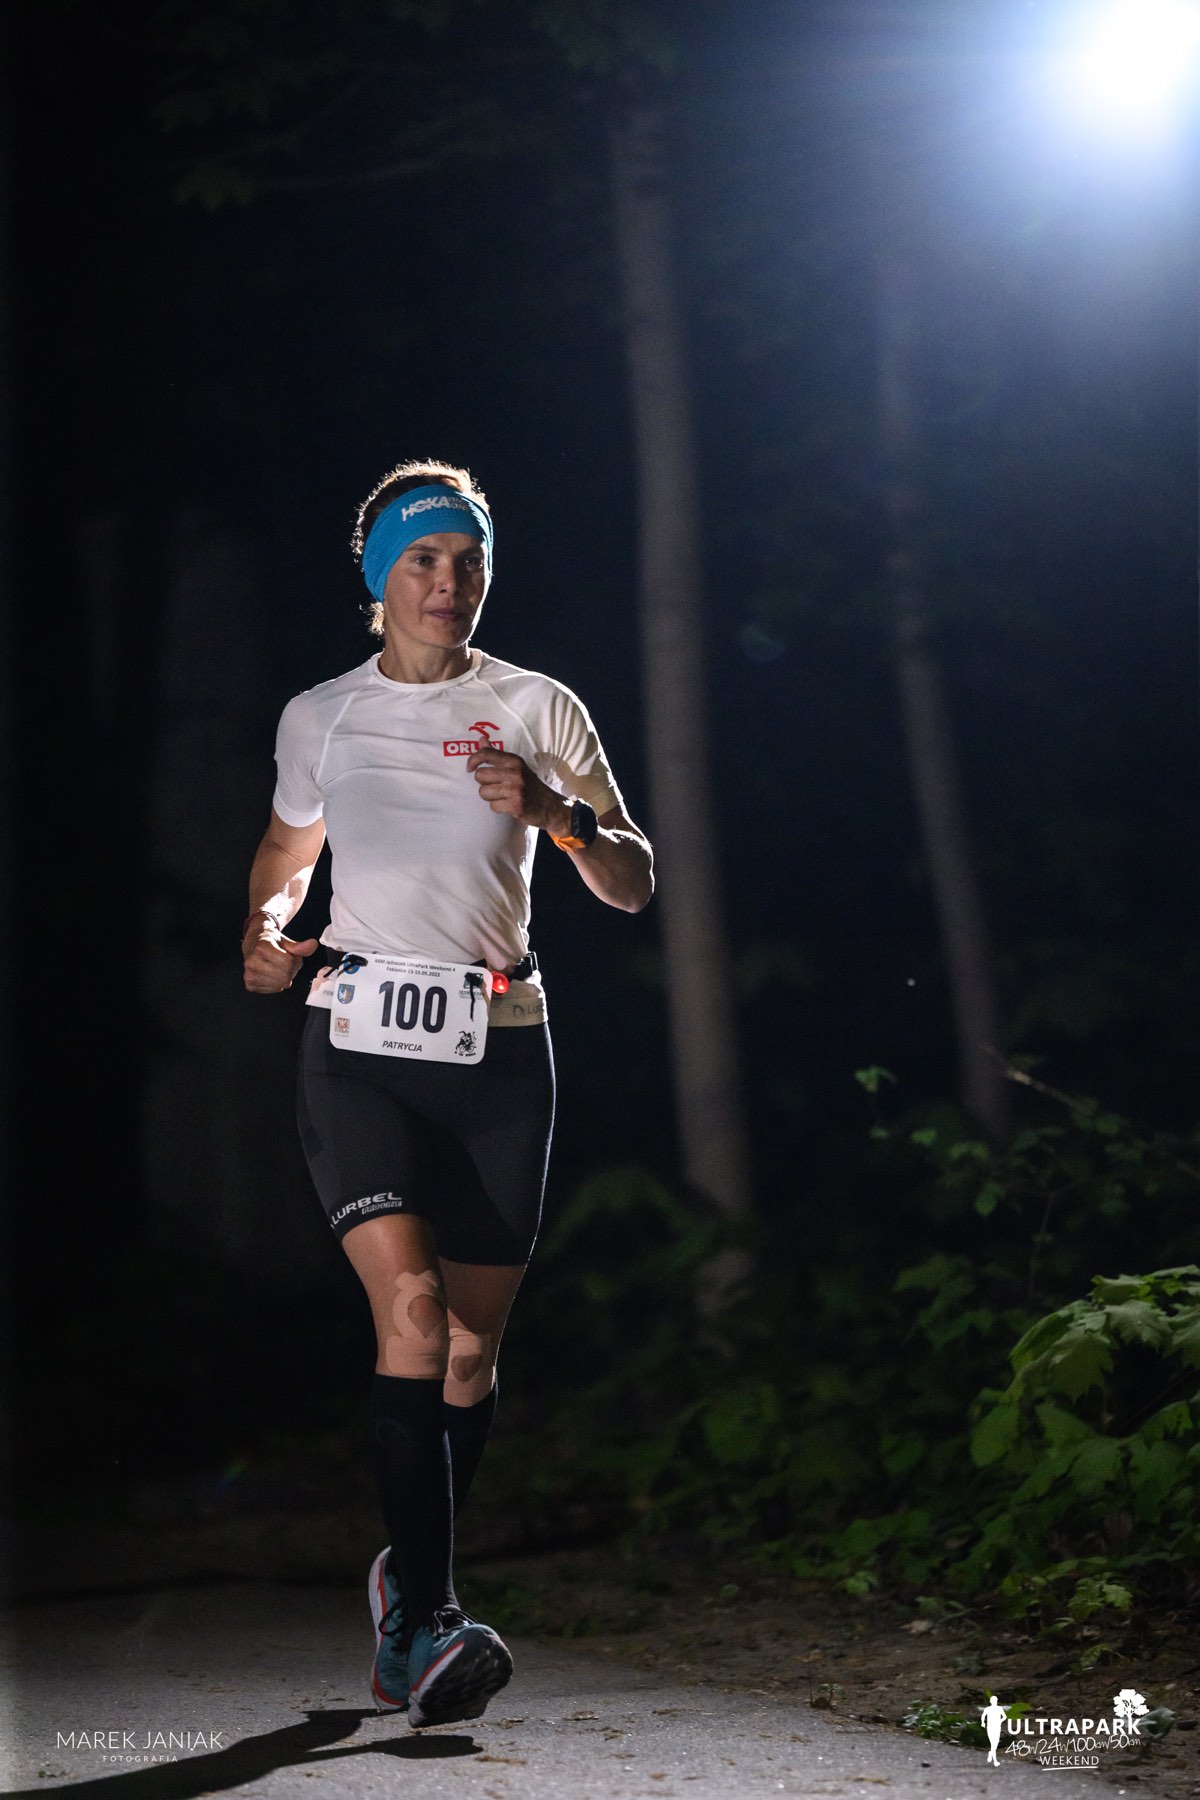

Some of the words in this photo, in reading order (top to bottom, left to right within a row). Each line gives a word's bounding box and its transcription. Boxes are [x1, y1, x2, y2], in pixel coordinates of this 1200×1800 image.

[401, 496, 449, 521] HOKA
[446, 742, 501, 755] ORL
[379, 980, 448, 1034] 100
[382, 1040, 423, 1053] PATRYCJA
[331, 1192, 403, 1225] LURBEL
